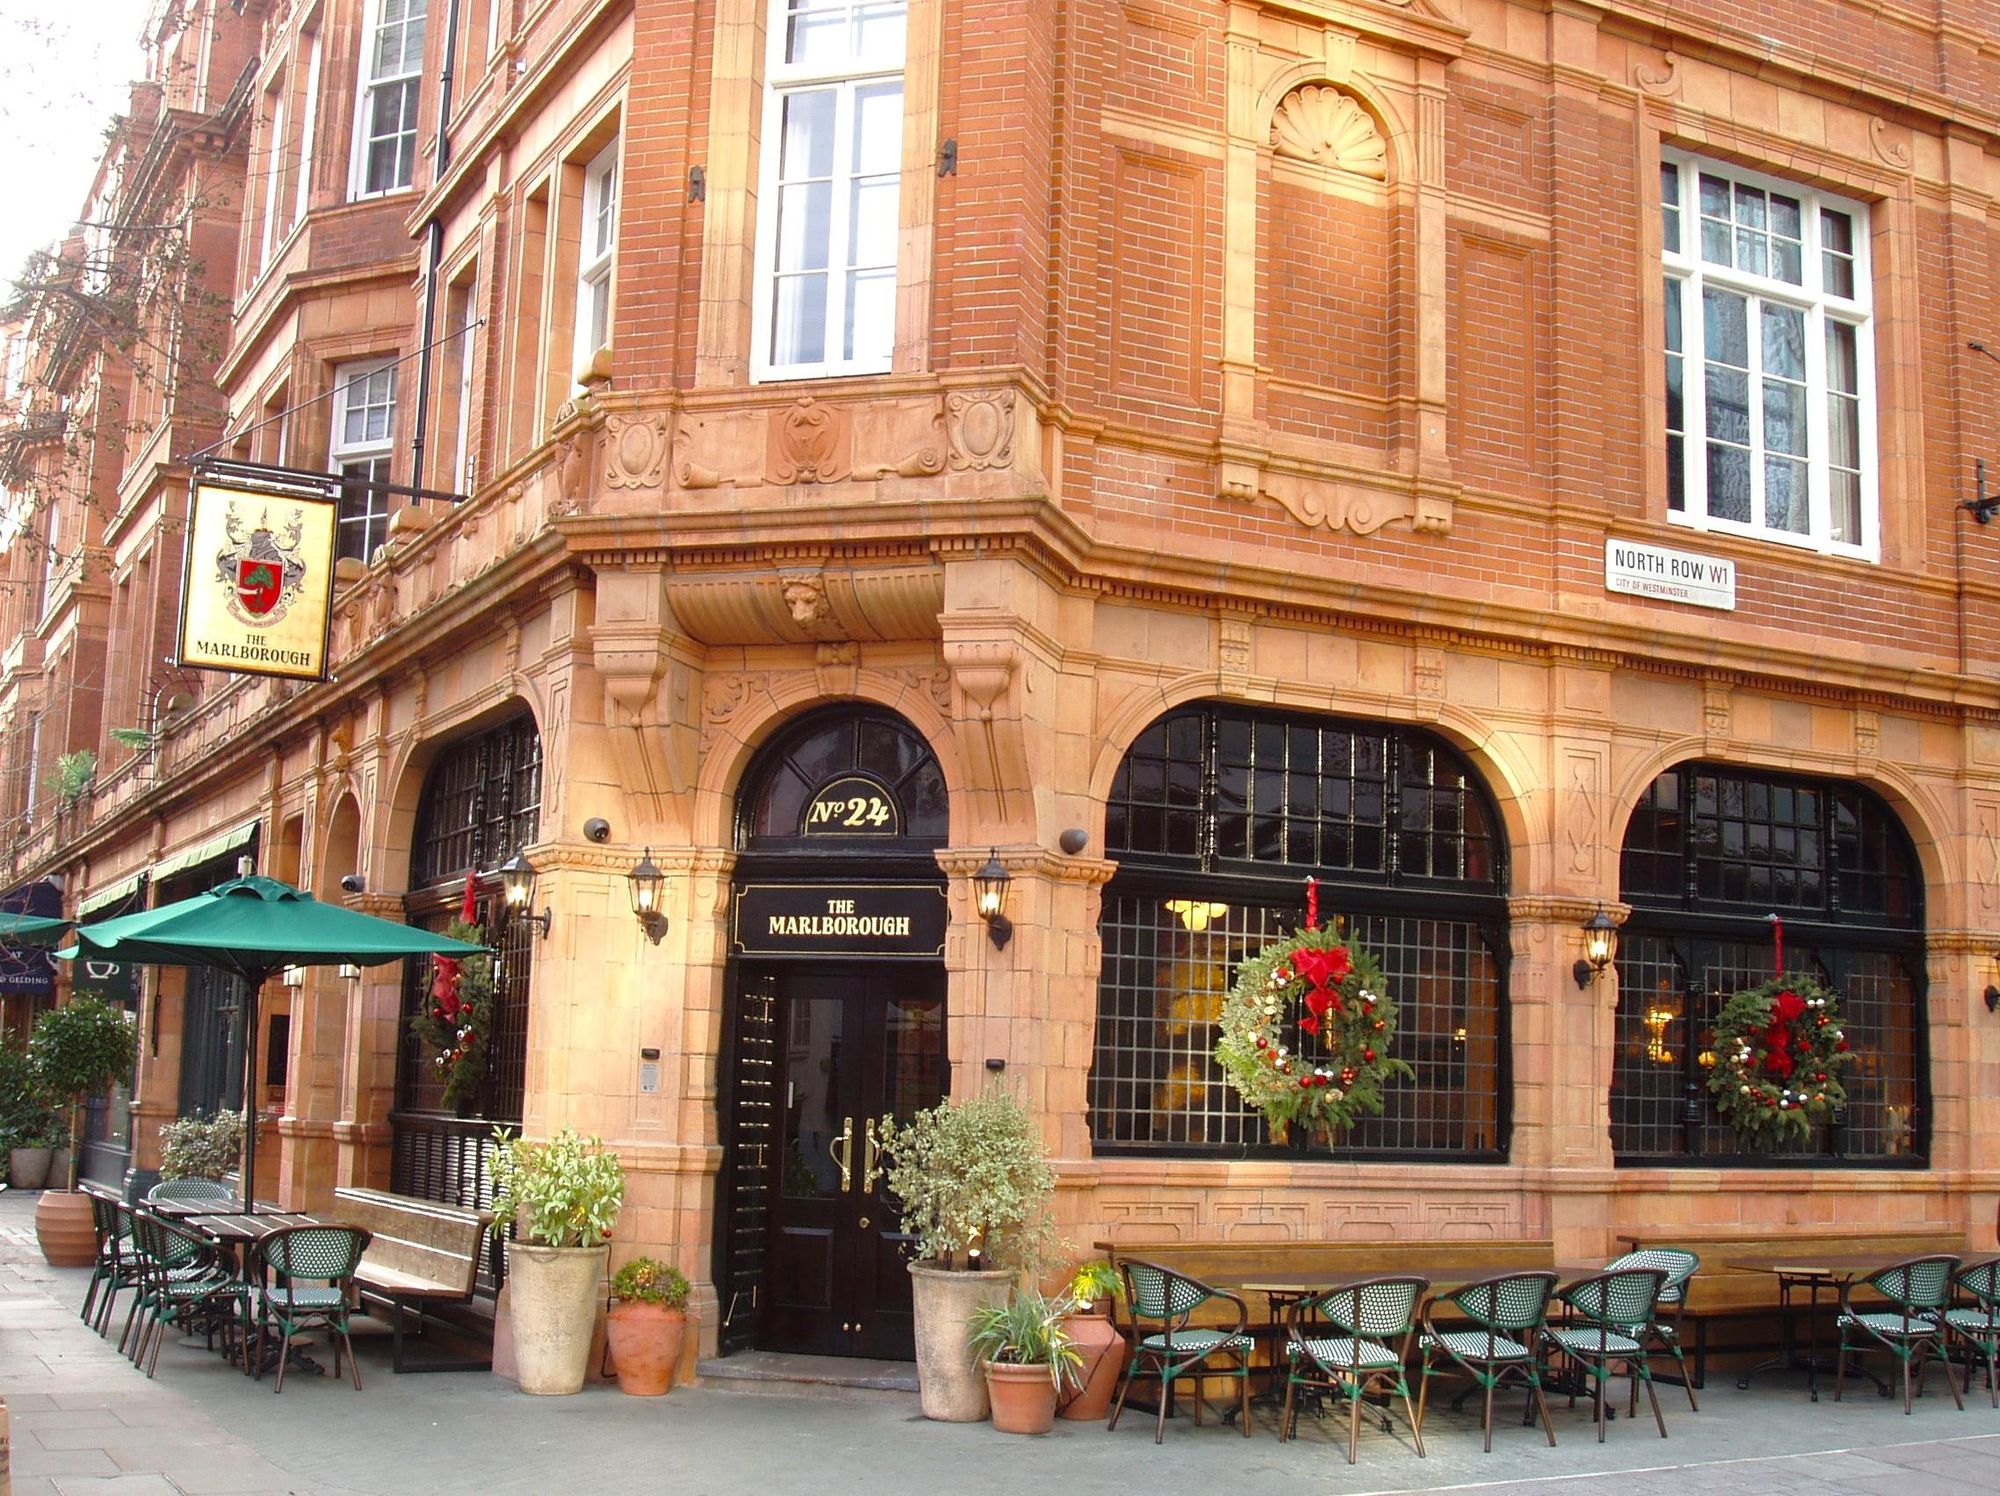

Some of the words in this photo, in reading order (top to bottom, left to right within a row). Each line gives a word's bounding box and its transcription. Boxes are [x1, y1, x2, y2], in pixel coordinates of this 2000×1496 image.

[1615, 548, 1664, 574] NORTH
[1671, 558, 1704, 581] ROW
[1709, 564, 1728, 585] W1
[1616, 577, 1630, 589] CITY
[1632, 580, 1641, 590] OF
[1642, 582, 1689, 599] WESTMINSTER
[245, 633, 267, 647] THE
[196, 639, 312, 667] MARLBOROUGH
[827, 899, 855, 914] THE
[768, 916, 910, 936] MARLBOROUGH
